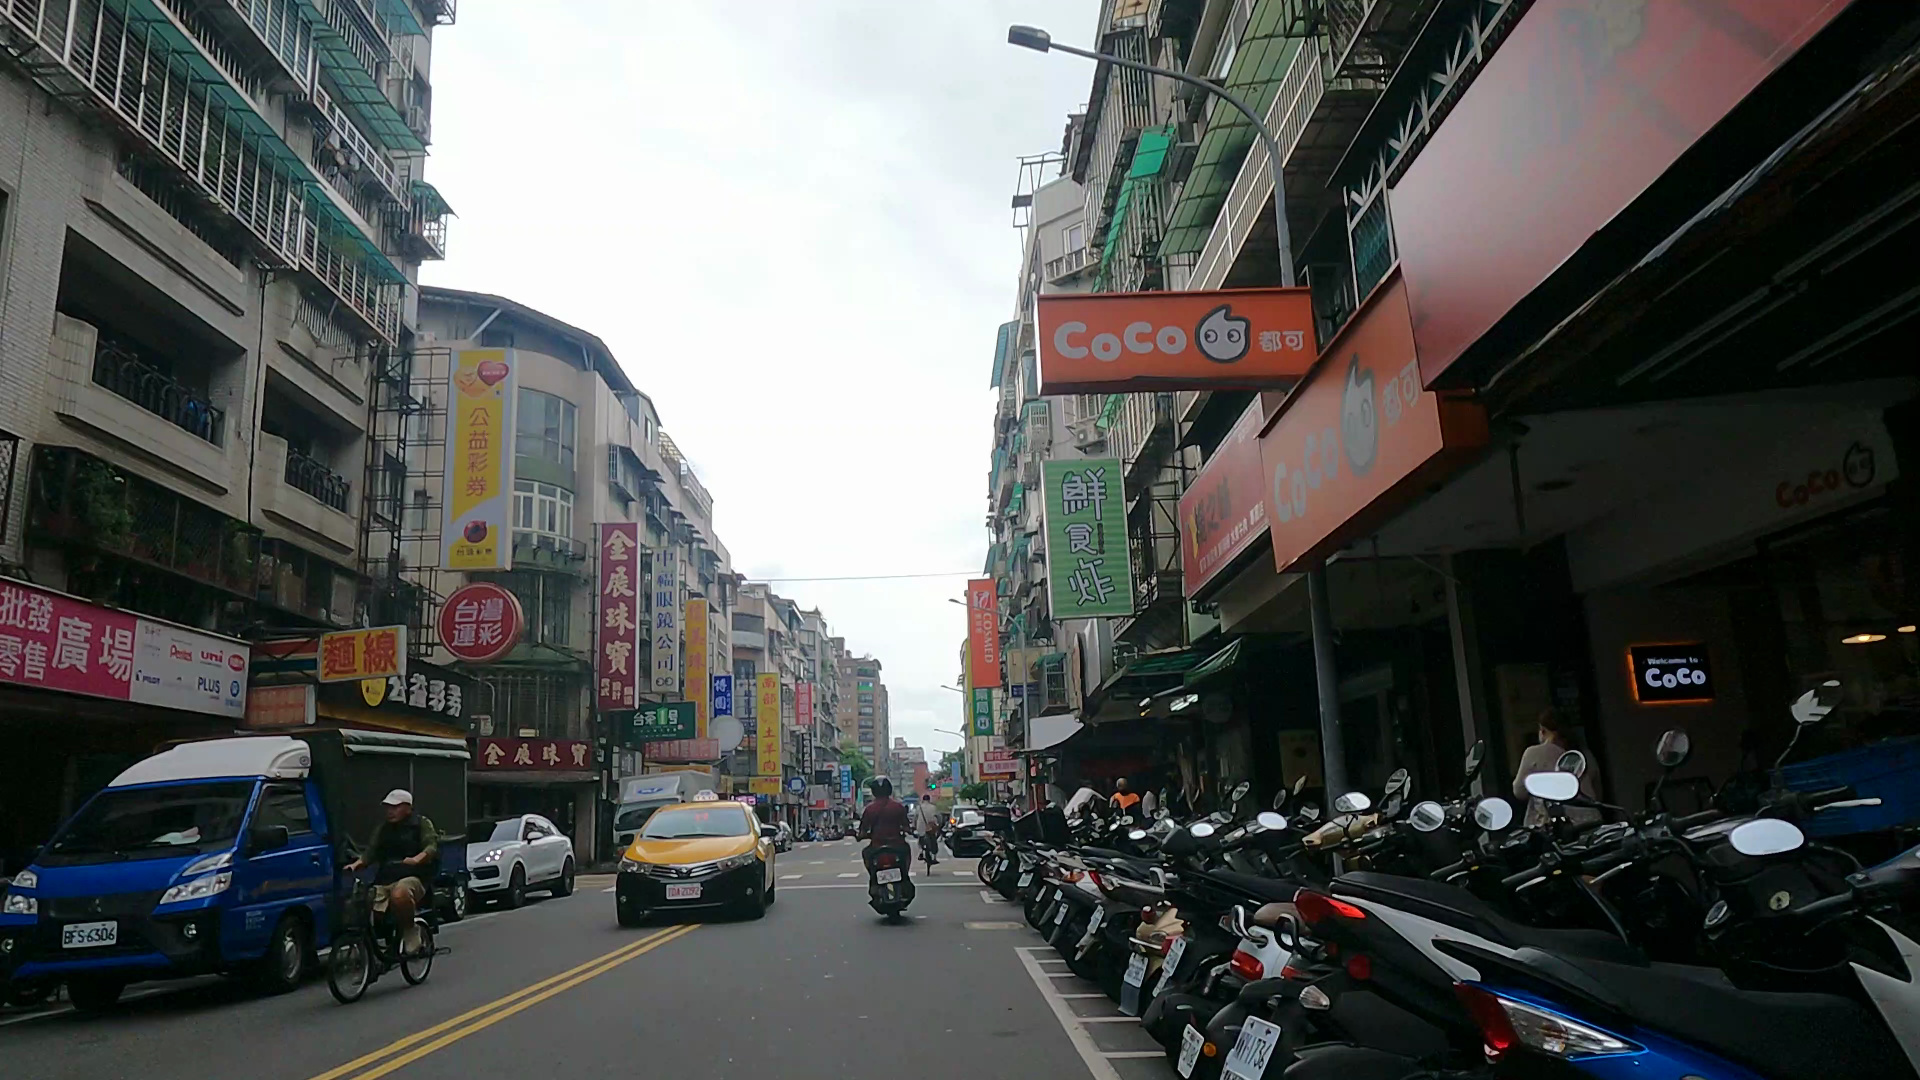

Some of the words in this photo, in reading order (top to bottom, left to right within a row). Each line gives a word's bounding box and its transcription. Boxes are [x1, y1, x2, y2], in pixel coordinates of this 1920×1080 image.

[1054, 321, 1188, 362] CoCo
[1259, 330, 1304, 353] 都可
[1383, 360, 1421, 427] 都可
[466, 406, 491, 497] 公益彩券
[0, 585, 53, 634] 批發
[454, 598, 503, 623] 台灣
[603, 529, 636, 676] 金展珠寶
[655, 549, 675, 671] 中福眼鏡公司
[0, 634, 48, 681] 零售
[51, 616, 133, 682] 廣場
[324, 632, 398, 676] 麵線
[452, 622, 503, 649] 運彩
[198, 676, 221, 694] PLUS
[1645, 668, 1707, 689] CoCo
[484, 742, 588, 767] 金展珠寶
